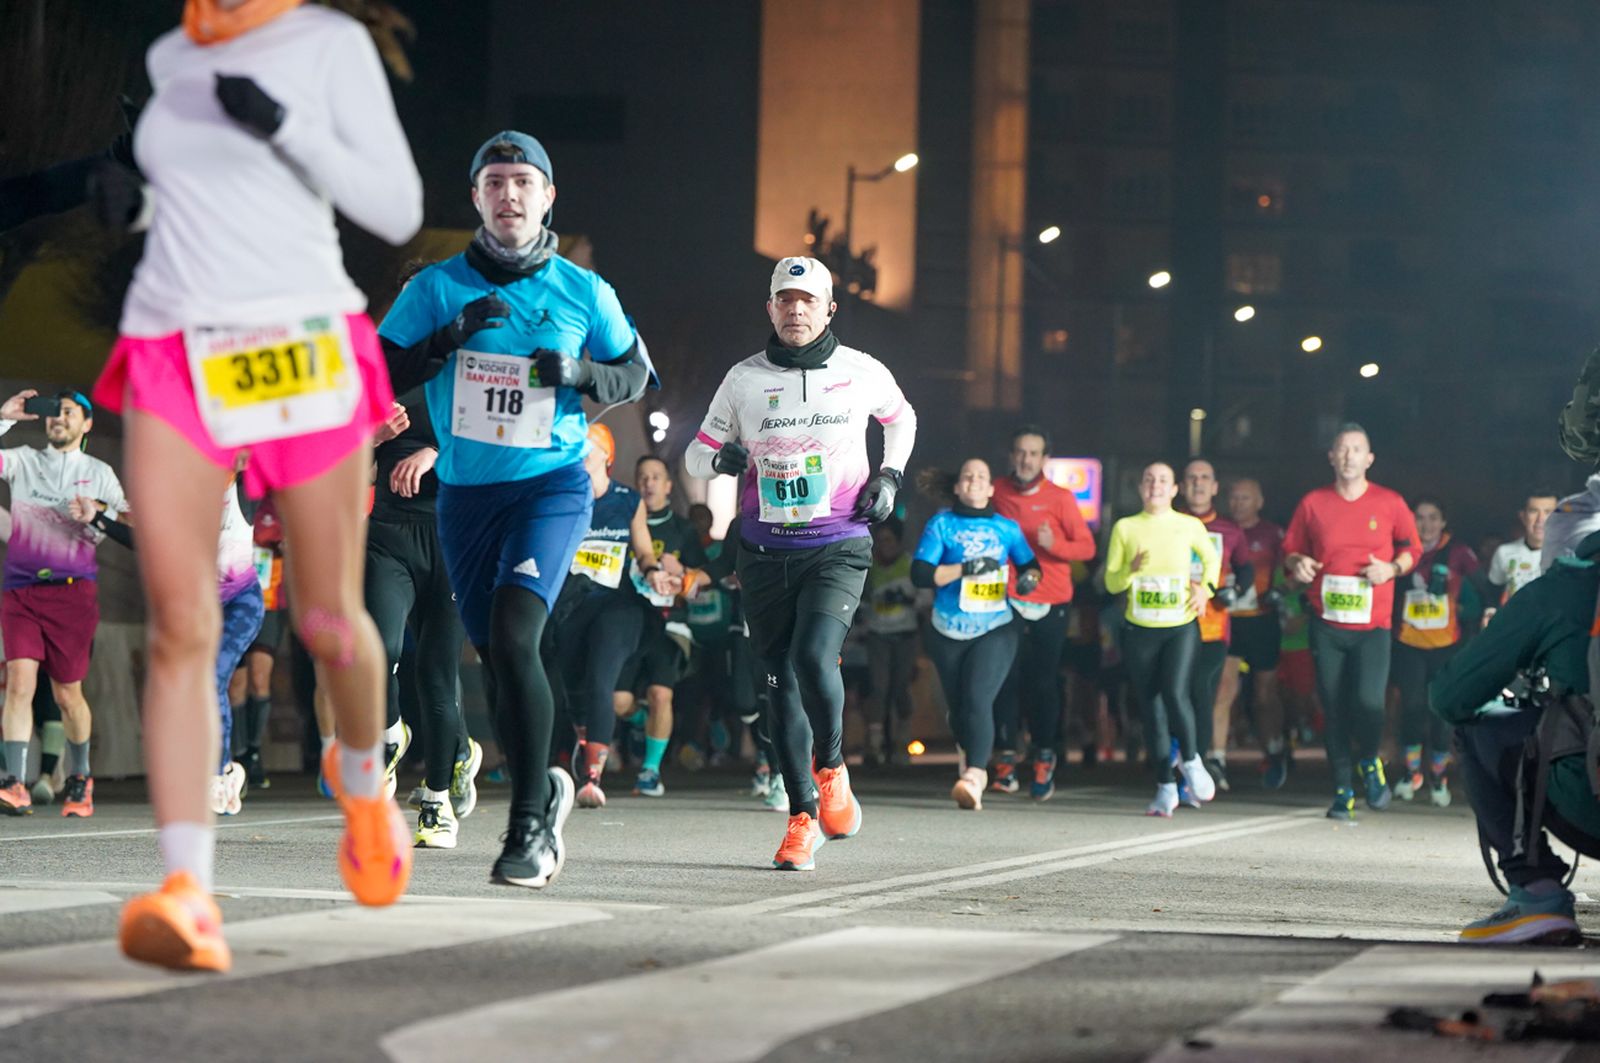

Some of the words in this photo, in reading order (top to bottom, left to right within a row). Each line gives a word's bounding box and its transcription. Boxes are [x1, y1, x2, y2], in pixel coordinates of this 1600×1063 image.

[232, 341, 316, 391] 3317
[478, 363, 507, 375] NOCHE
[509, 366, 520, 376] DE
[465, 372, 485, 383] SAN
[484, 387, 524, 416] 118
[759, 417, 796, 432] SIERRA
[798, 417, 808, 425] DE
[808, 413, 849, 427] SEGURA
[775, 476, 809, 501] 610
[1141, 592, 1177, 605] 12420
